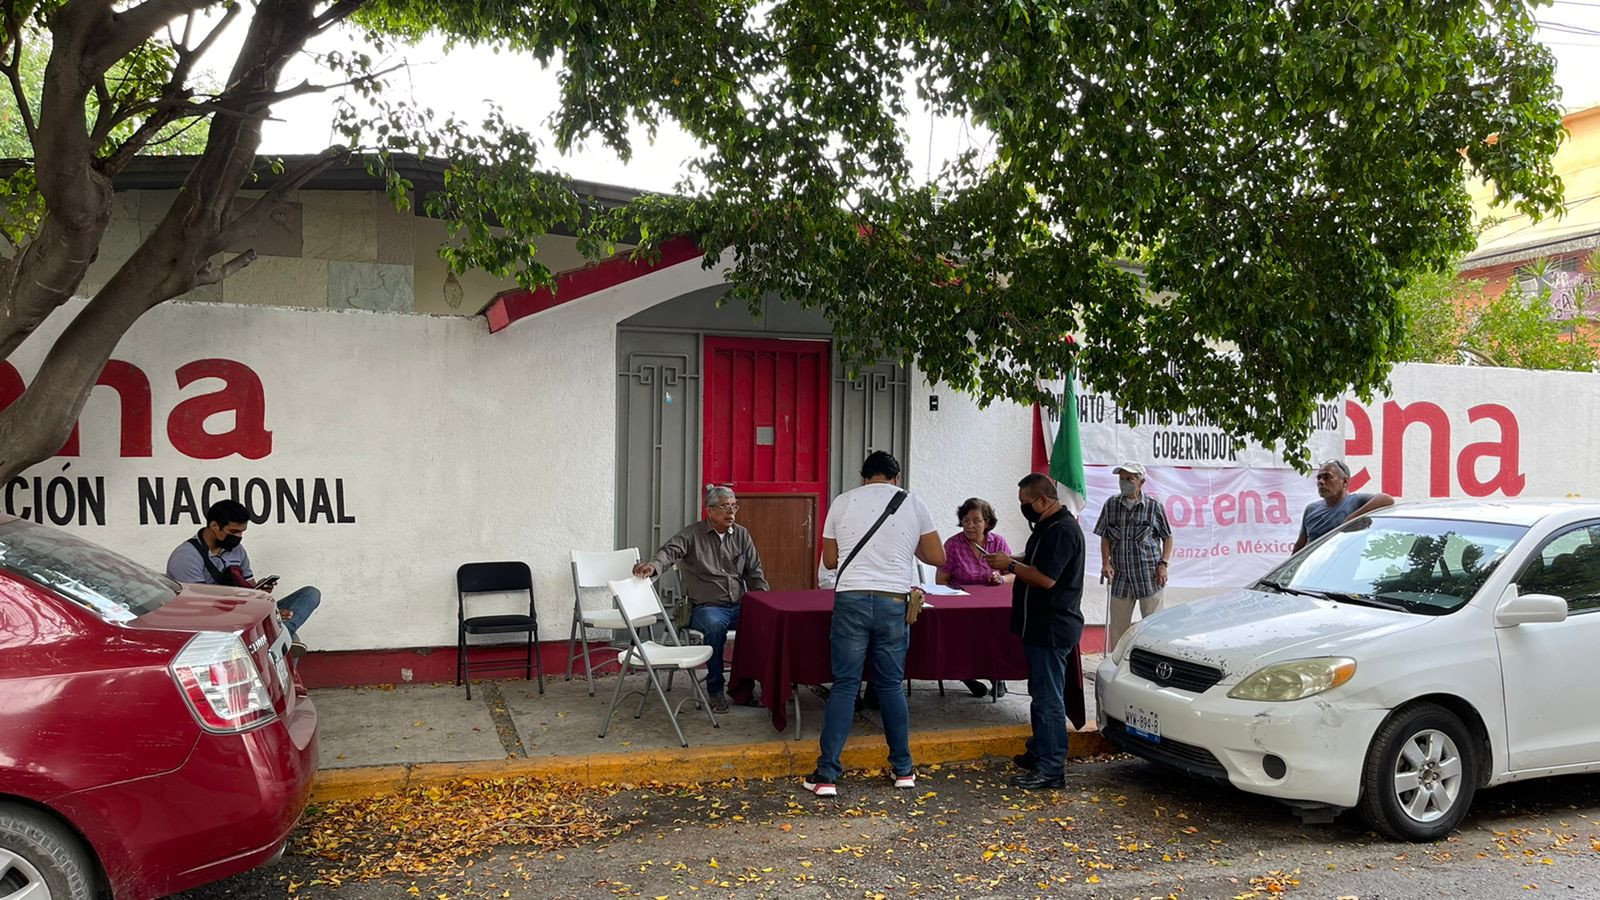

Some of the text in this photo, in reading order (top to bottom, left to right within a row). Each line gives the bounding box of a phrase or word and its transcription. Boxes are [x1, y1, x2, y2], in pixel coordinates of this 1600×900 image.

[0, 358, 273, 460] na
[1152, 430, 1237, 461] GOBERNADOR
[4, 461, 356, 526] CIÓN NACIONAL
[1147, 488, 1292, 528] orena
[1171, 539, 1295, 558] ranza de México
